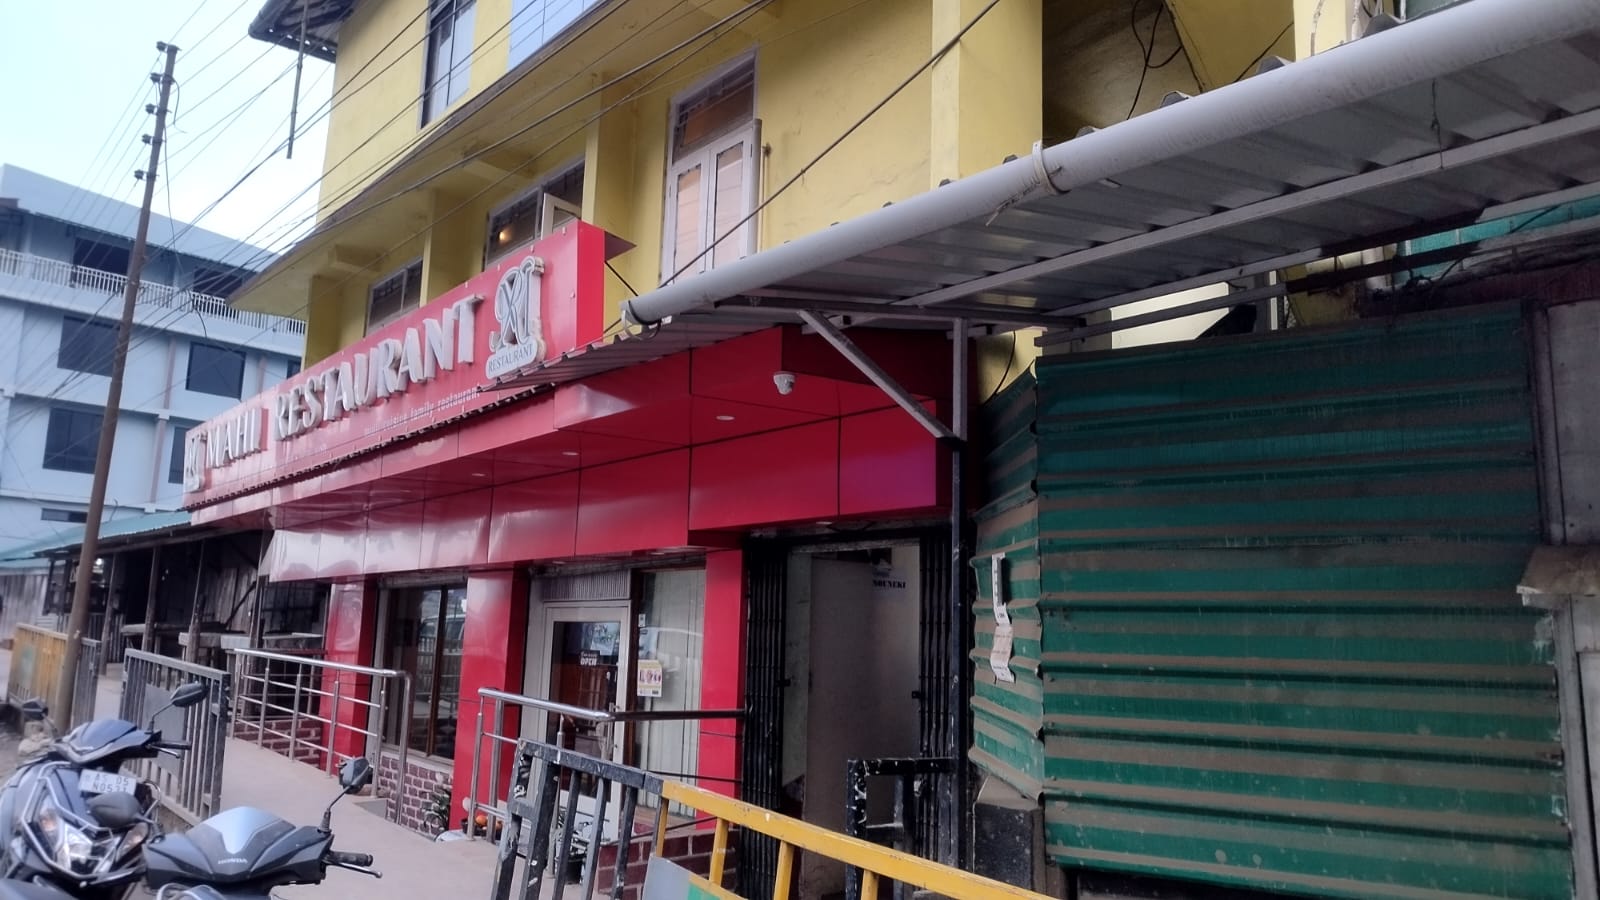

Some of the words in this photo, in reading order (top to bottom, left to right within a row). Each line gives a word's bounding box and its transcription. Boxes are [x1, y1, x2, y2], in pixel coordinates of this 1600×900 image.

[488, 344, 533, 374] RESTAURANT
[206, 408, 263, 468] MAHI
[274, 294, 485, 441] RESTAURANT
[410, 401, 434, 421] family
